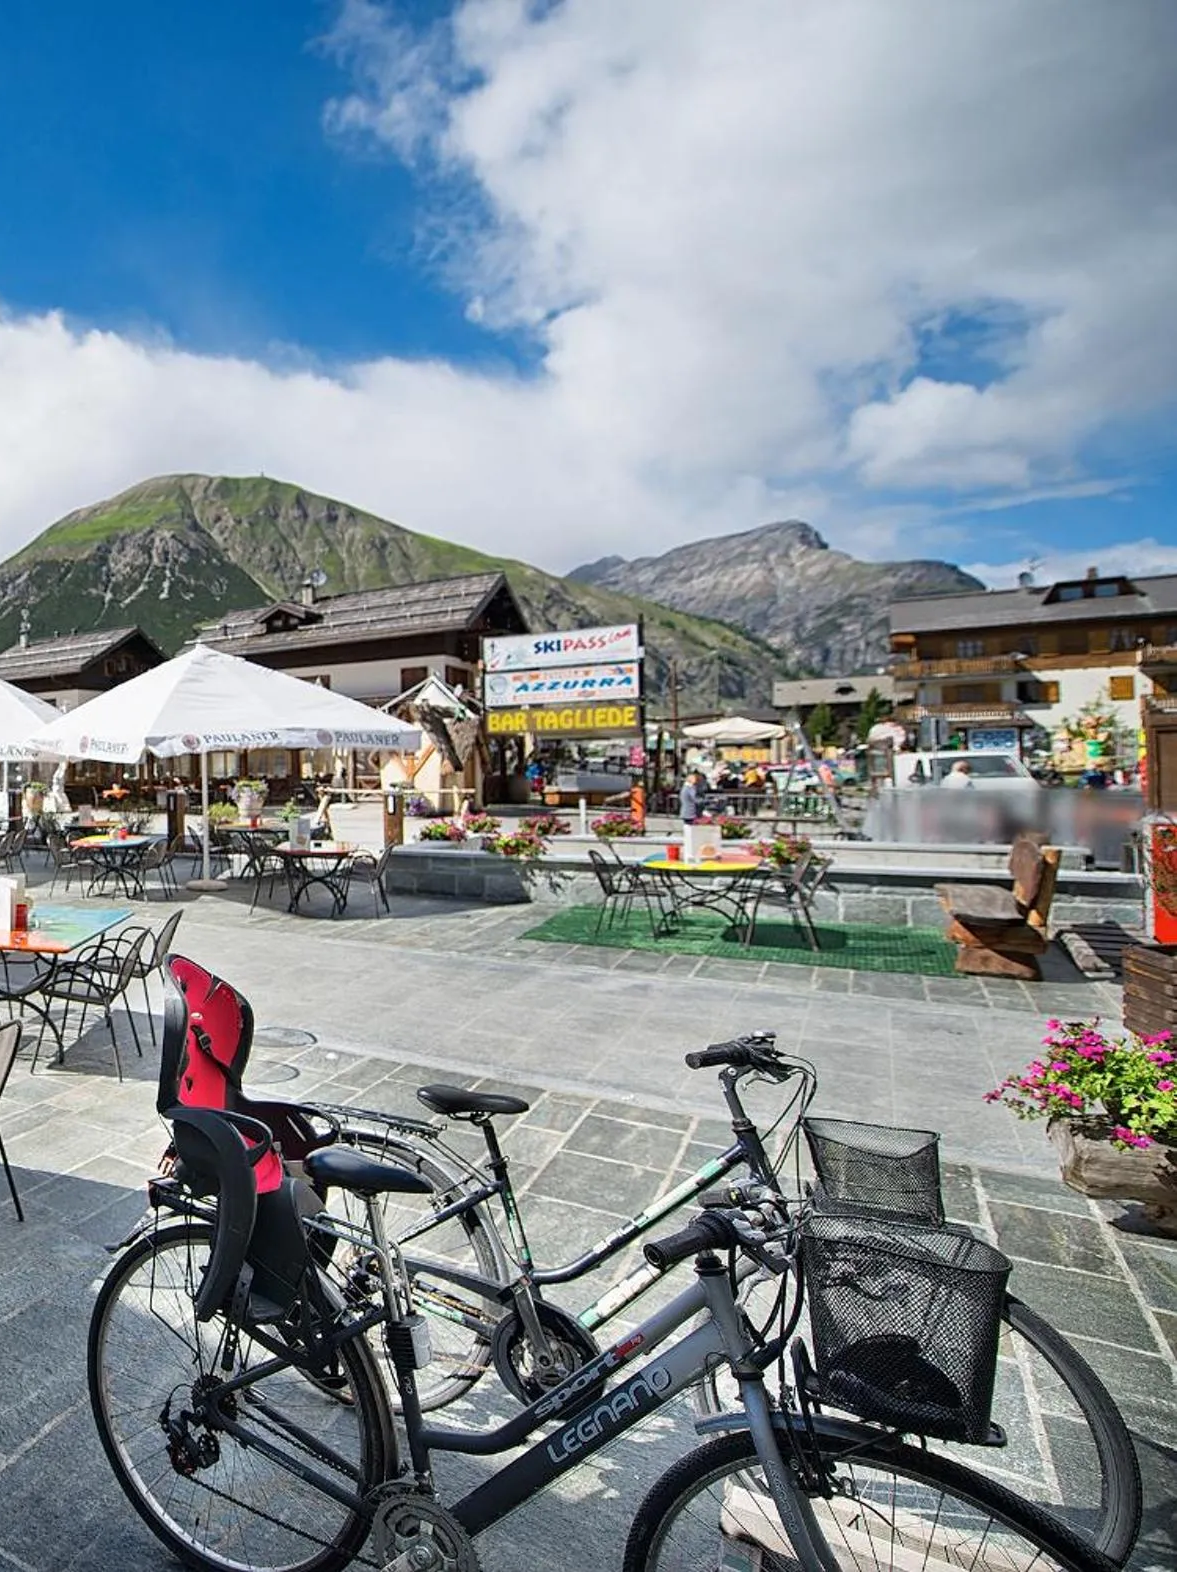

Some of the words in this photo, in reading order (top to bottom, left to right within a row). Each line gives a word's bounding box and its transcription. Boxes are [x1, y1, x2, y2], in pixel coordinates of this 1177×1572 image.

[515, 676, 634, 693] AZZURRA
[487, 711, 528, 733] BAR
[532, 705, 638, 731] TAGLIEDE
[203, 731, 280, 744] PAULANER
[334, 730, 402, 746] PAULANER
[546, 1367, 672, 1463] LEGNANO
